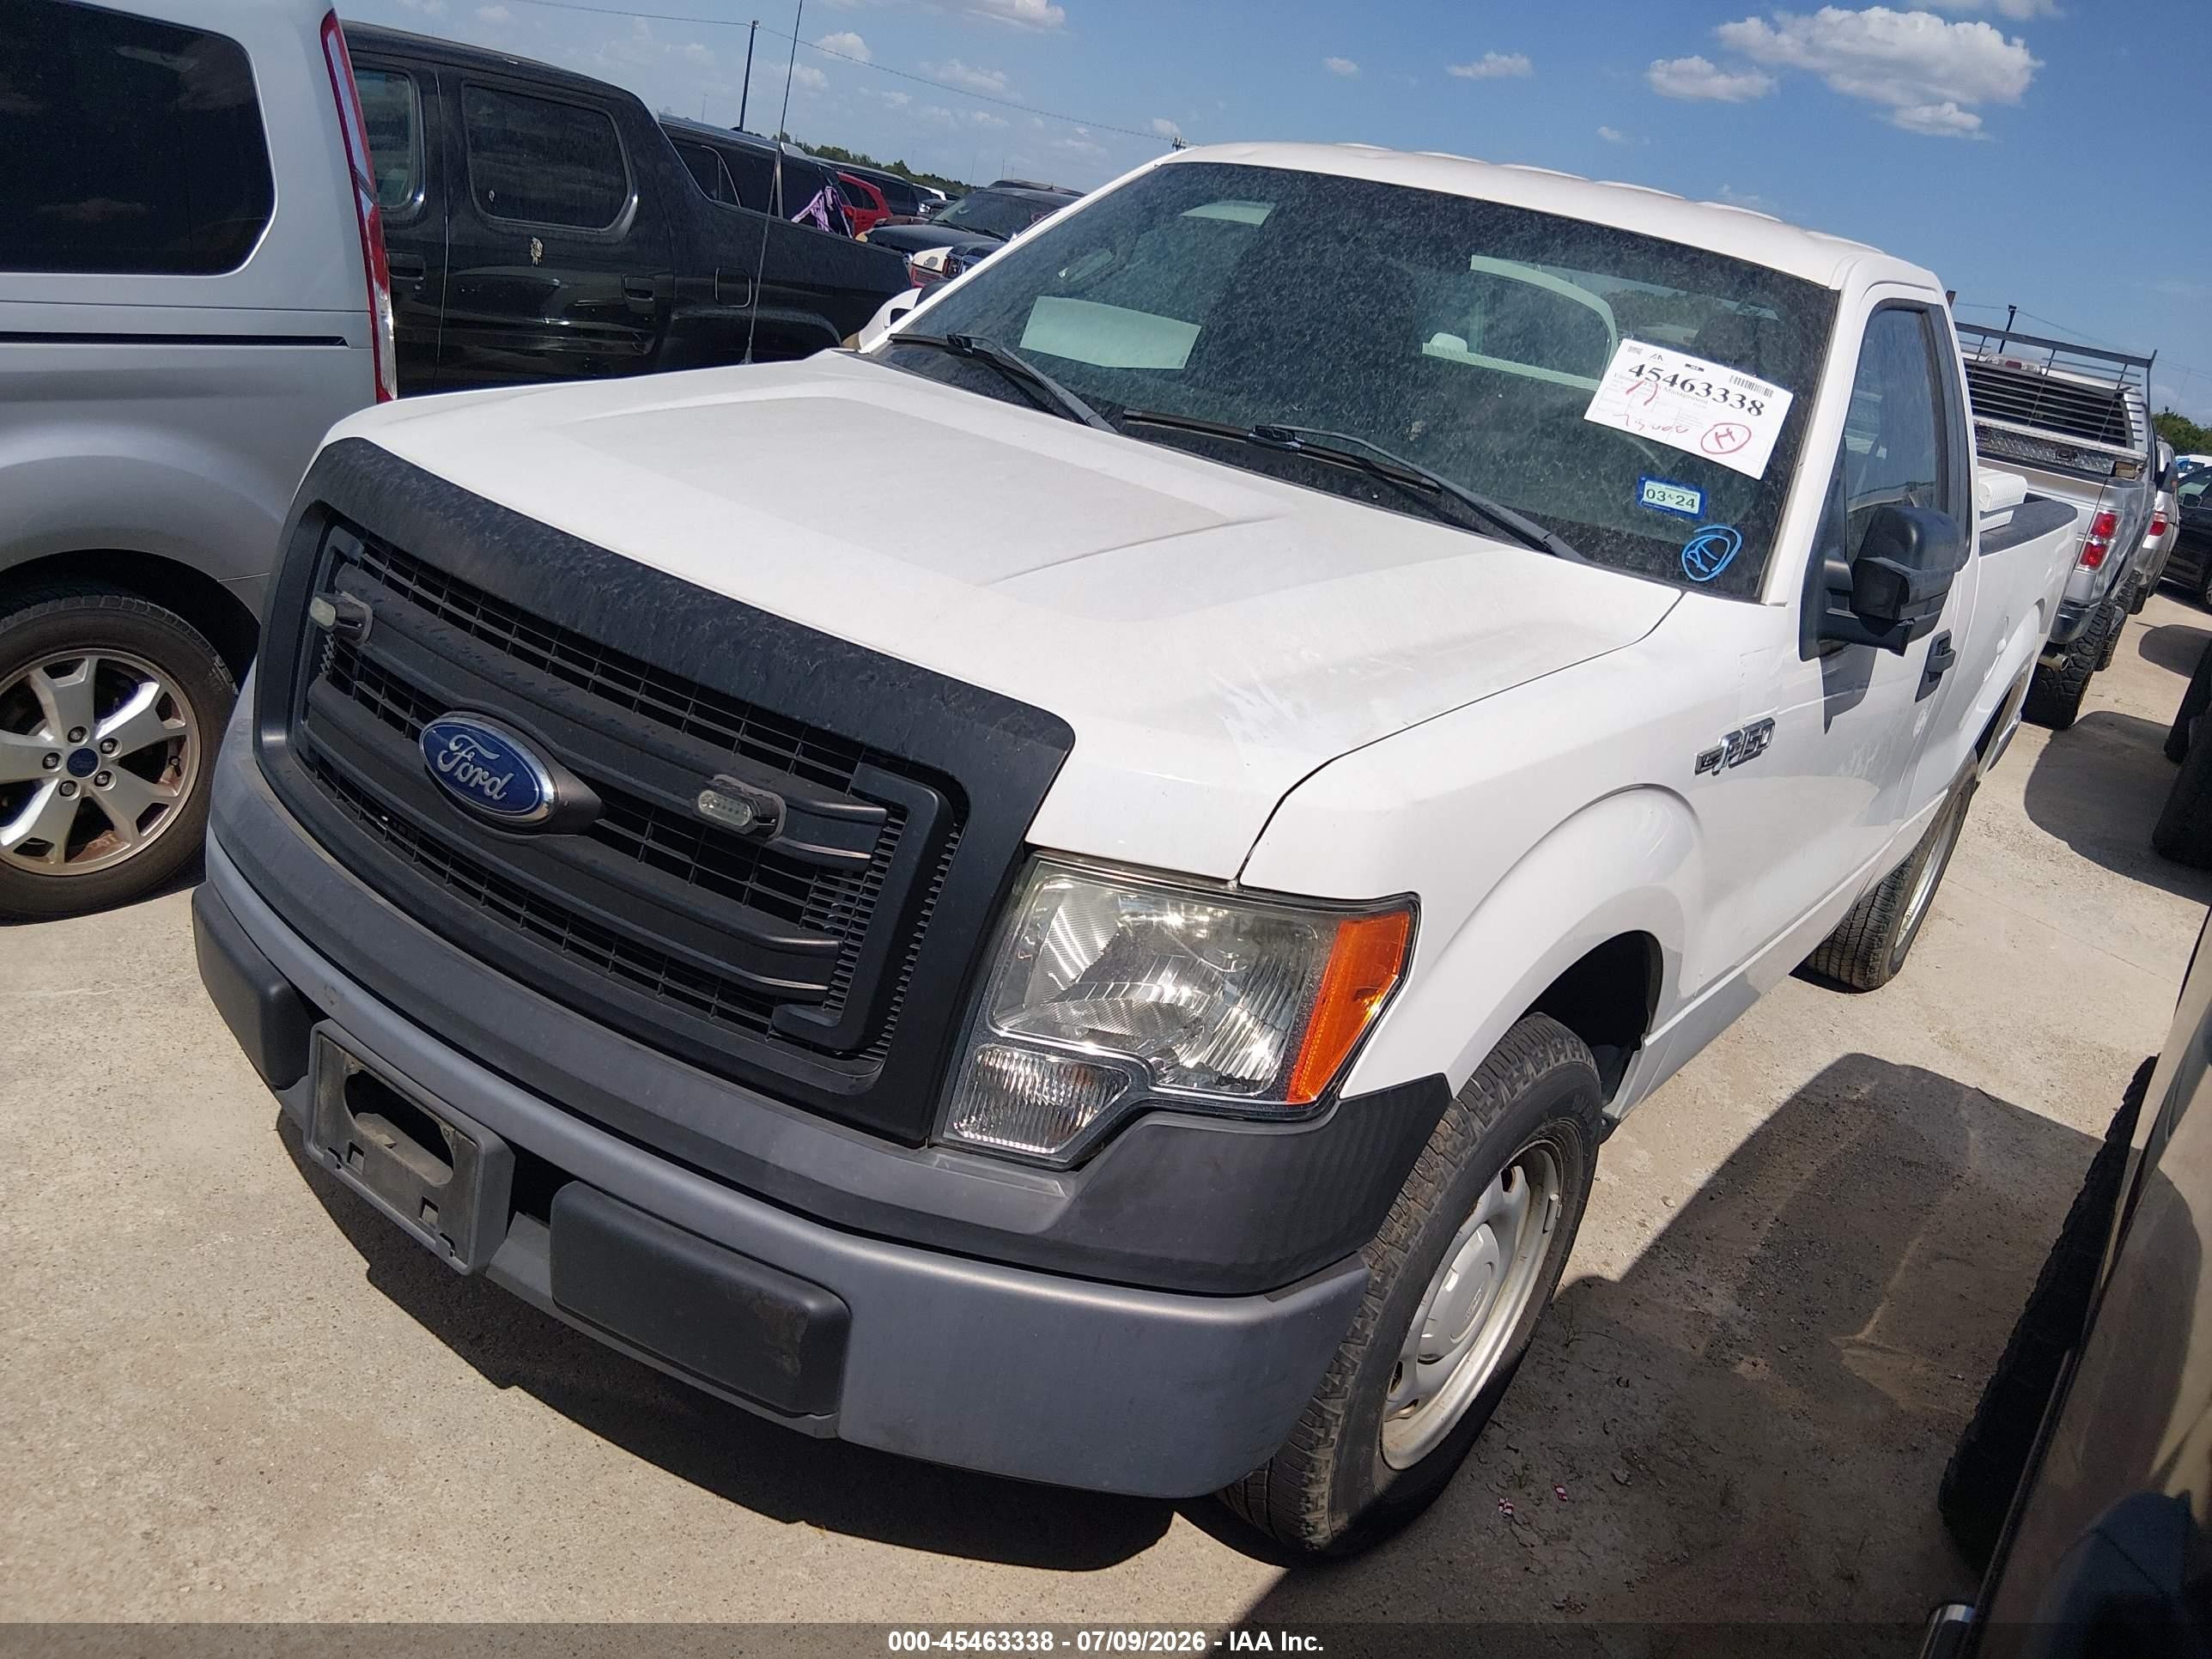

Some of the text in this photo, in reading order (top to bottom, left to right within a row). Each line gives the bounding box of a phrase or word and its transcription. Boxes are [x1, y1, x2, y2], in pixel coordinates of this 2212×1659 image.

[1628, 363, 1765, 416] 45463338
[1646, 489, 1666, 502] 03
[1674, 495, 1695, 508] 24
[437, 734, 514, 800] Ford
